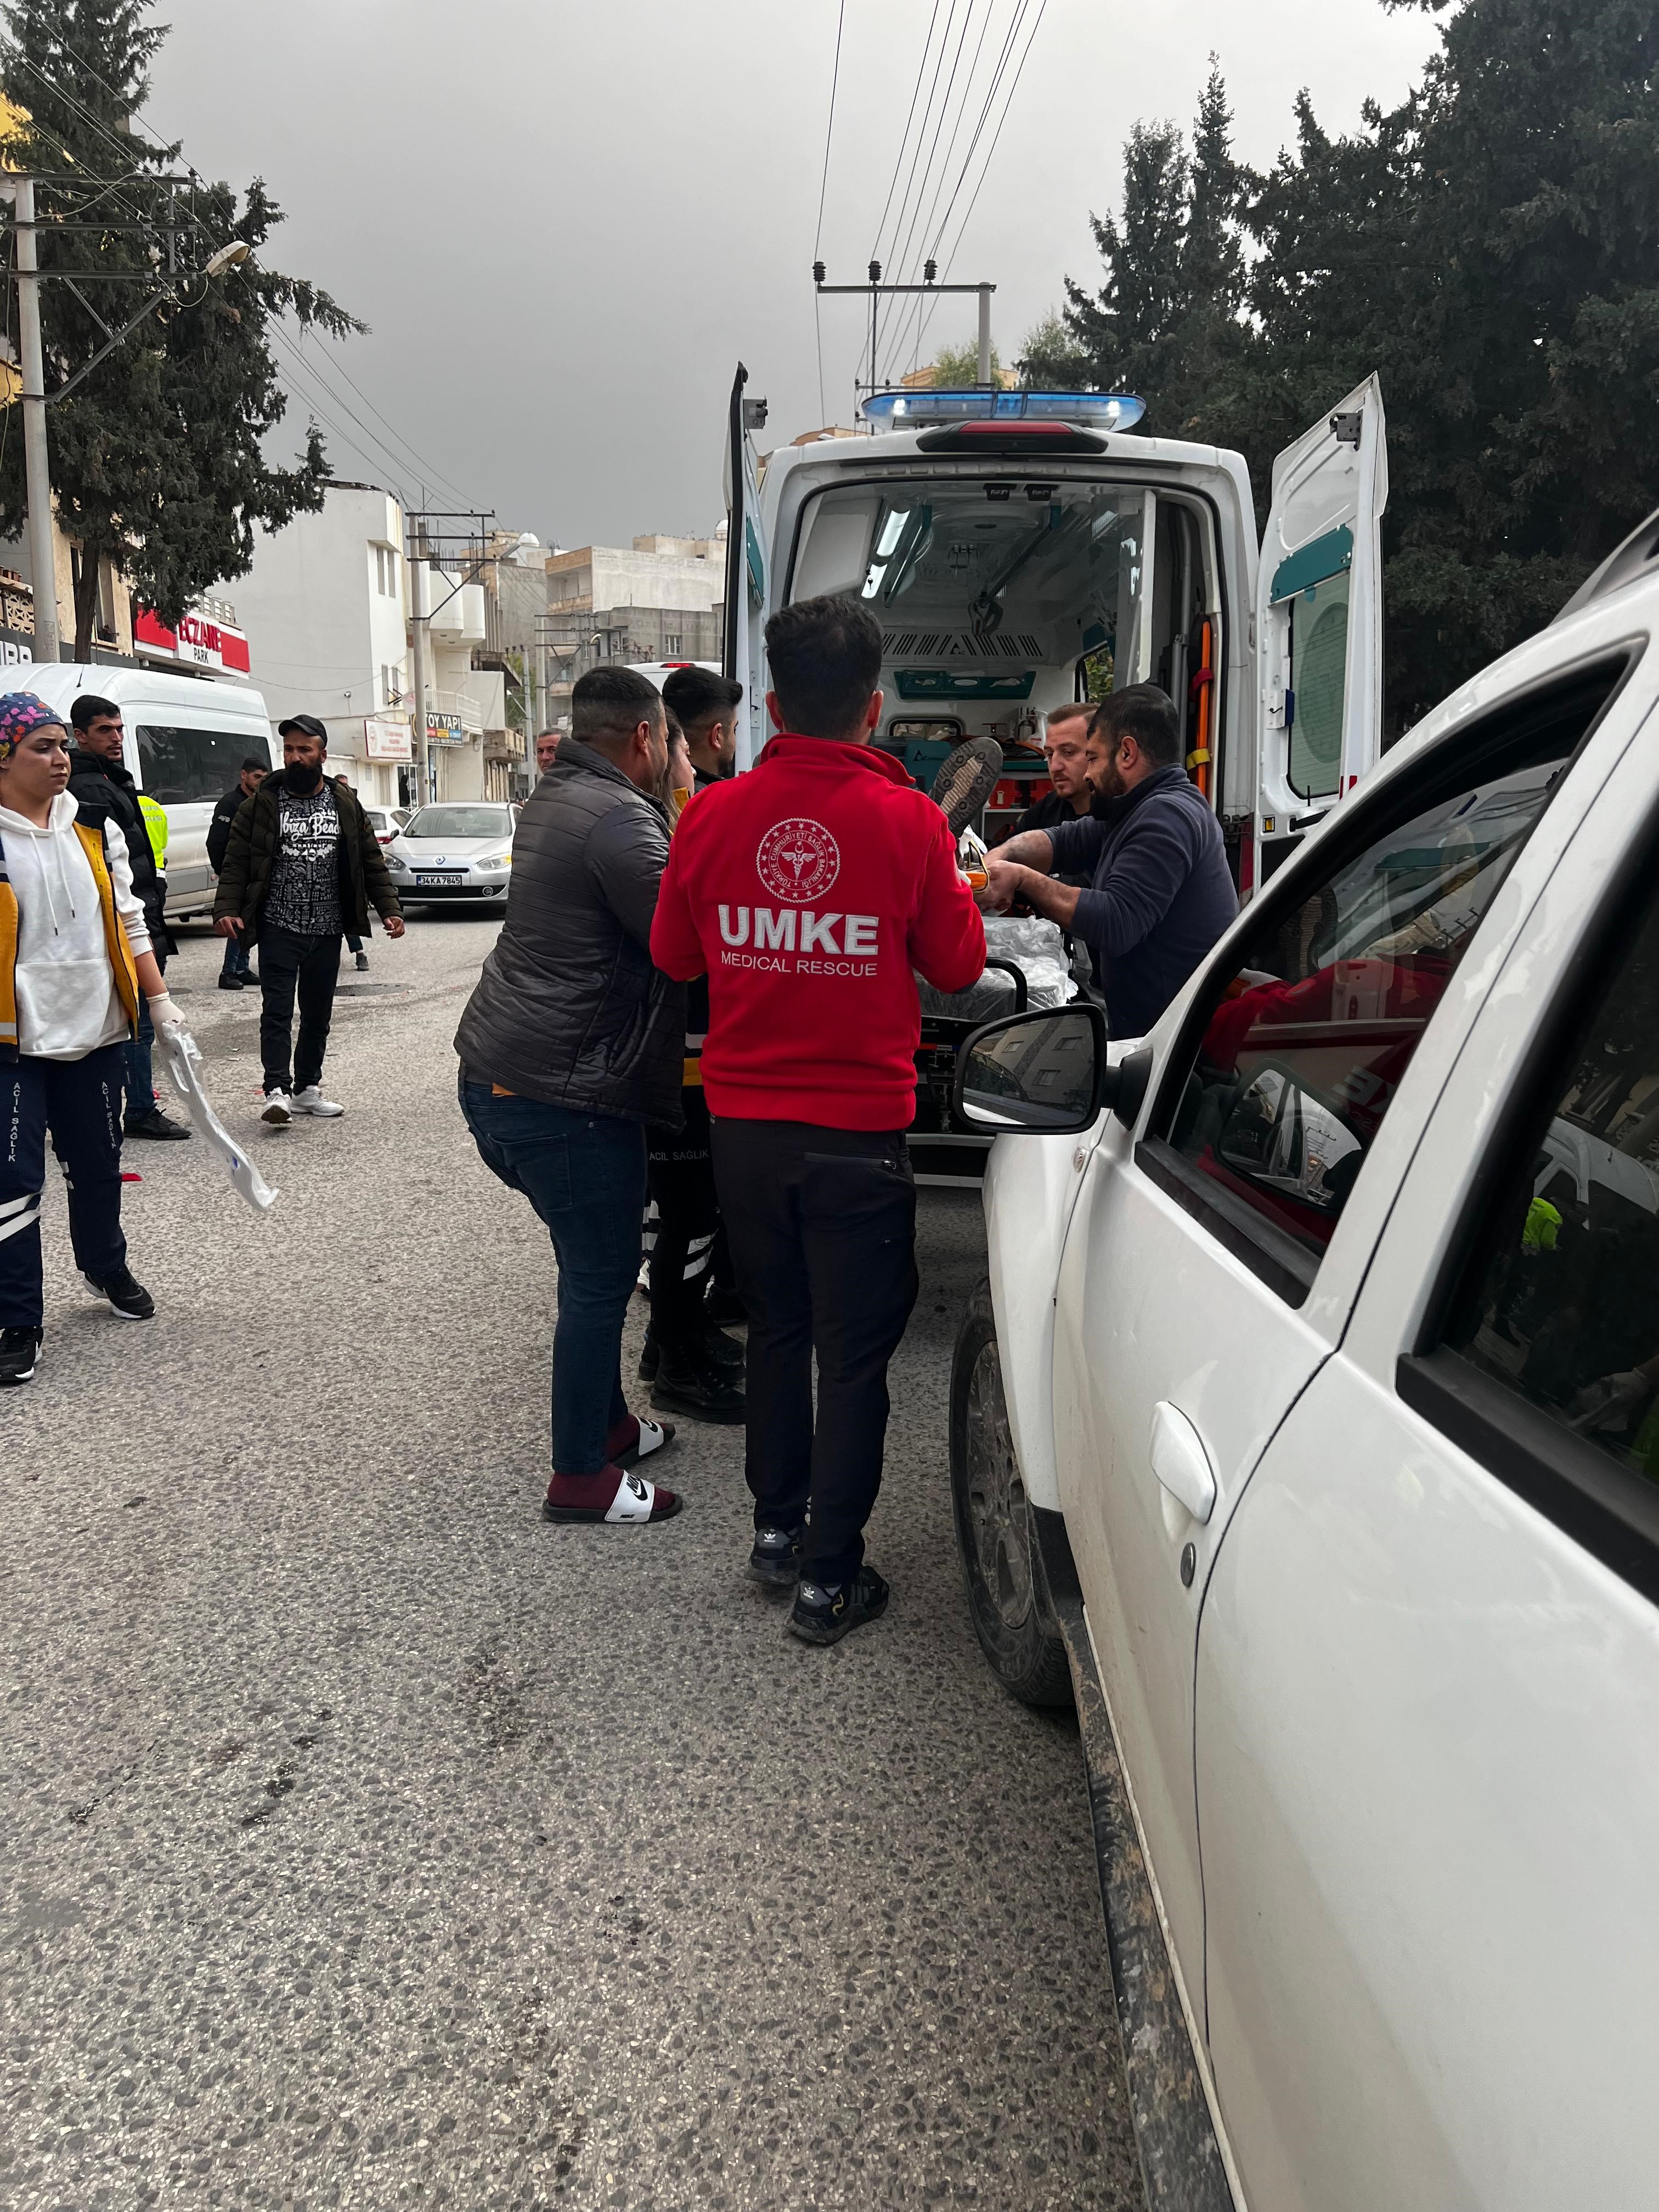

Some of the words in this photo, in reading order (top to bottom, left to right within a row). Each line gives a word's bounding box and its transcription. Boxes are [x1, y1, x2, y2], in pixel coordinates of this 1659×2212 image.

[179, 616, 222, 653] ECZANE
[194, 647, 208, 664] PARK
[426, 713, 439, 729] OY
[441, 715, 461, 731] YAPI
[279, 811, 308, 841] Ibiza
[718, 905, 879, 955] UMKE
[721, 951, 791, 973] MEDICAL
[797, 960, 877, 977] RESCUE
